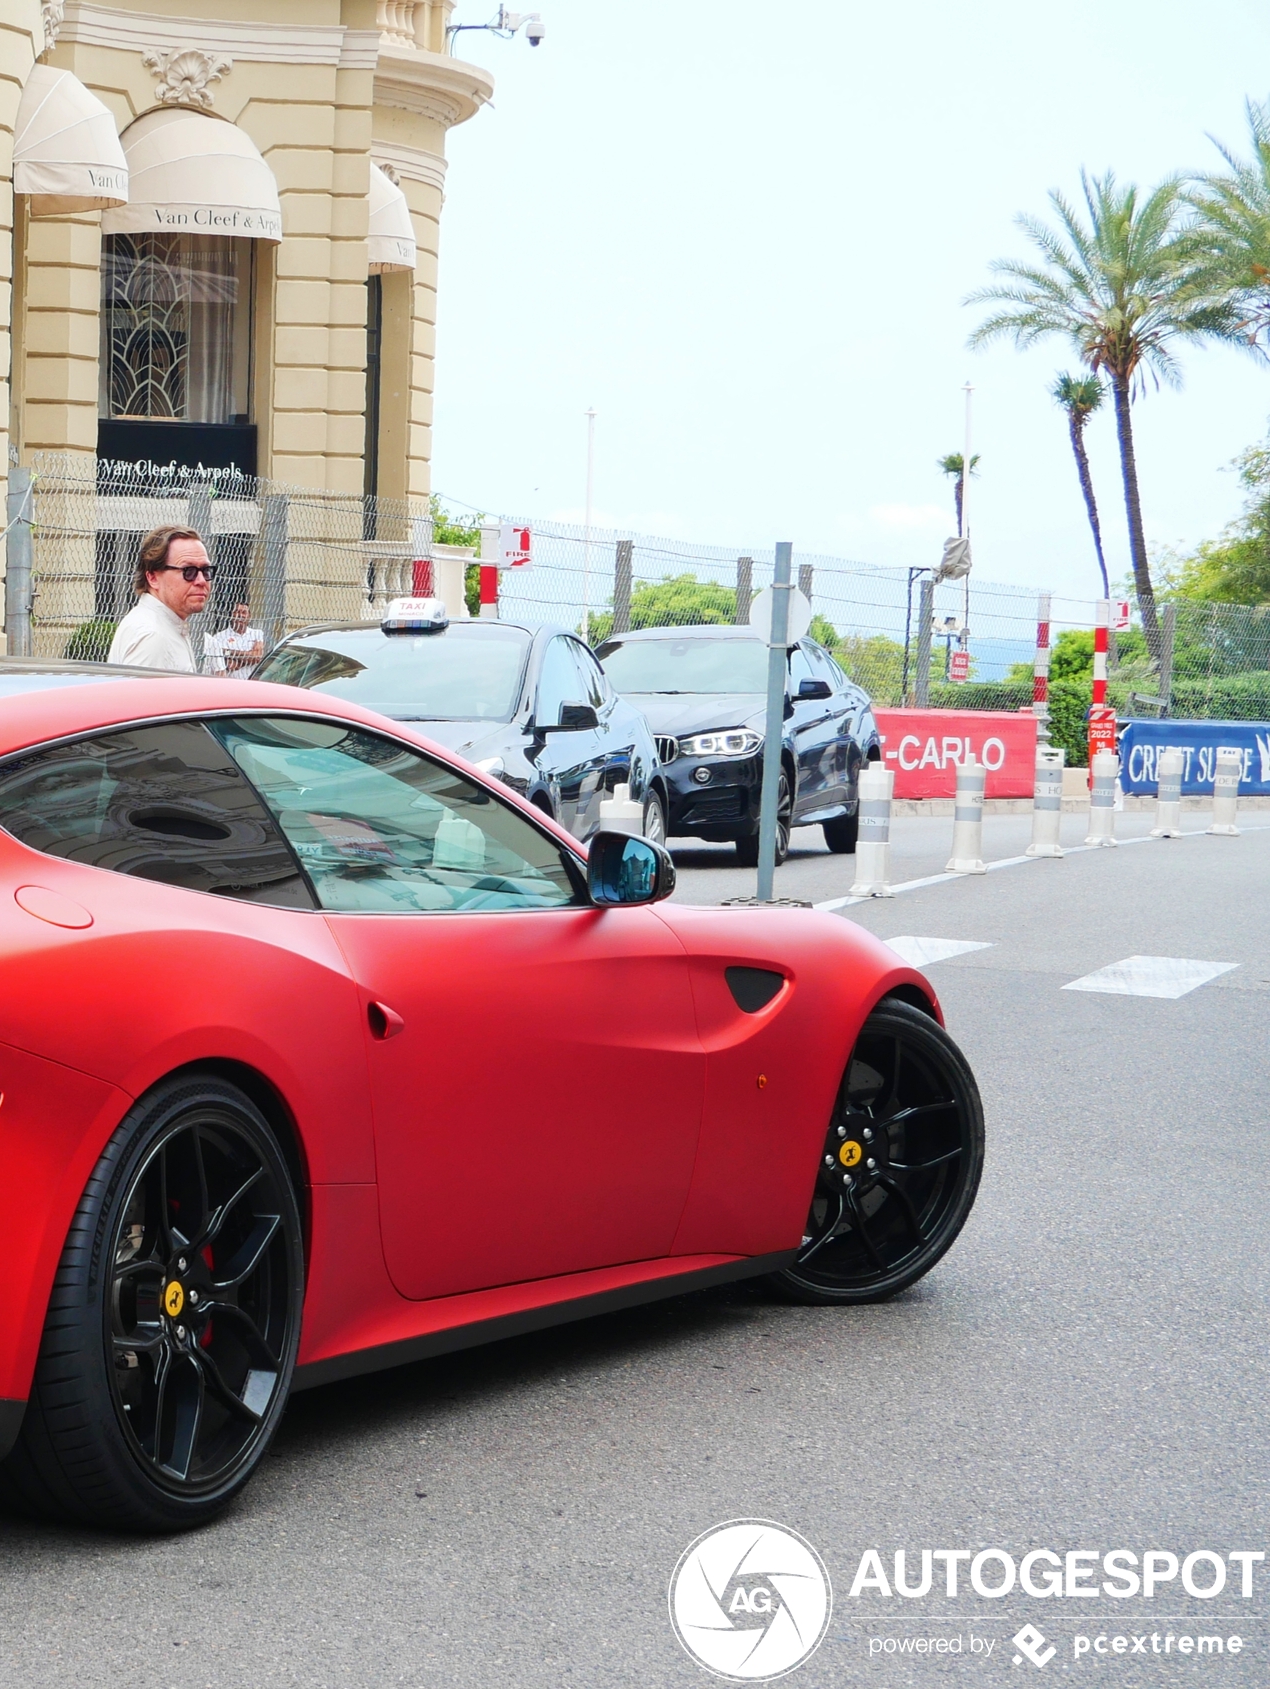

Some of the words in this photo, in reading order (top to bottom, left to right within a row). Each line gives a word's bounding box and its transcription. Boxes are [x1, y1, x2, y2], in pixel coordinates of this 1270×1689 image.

[88, 169, 113, 188] Van
[155, 209, 188, 225] Van
[194, 209, 240, 227] Cleef
[243, 216, 254, 229] &
[102, 459, 131, 477] Van
[136, 459, 177, 478] Cleef
[180, 464, 191, 478] &
[196, 462, 242, 483] Arpels
[400, 602, 426, 610] TAXI
[1090, 730, 1112, 739] 2022
[880, 734, 1005, 771] -CARLO
[1129, 745, 1195, 783] CRET
[89, 1193, 112, 1279] MICHELIN
